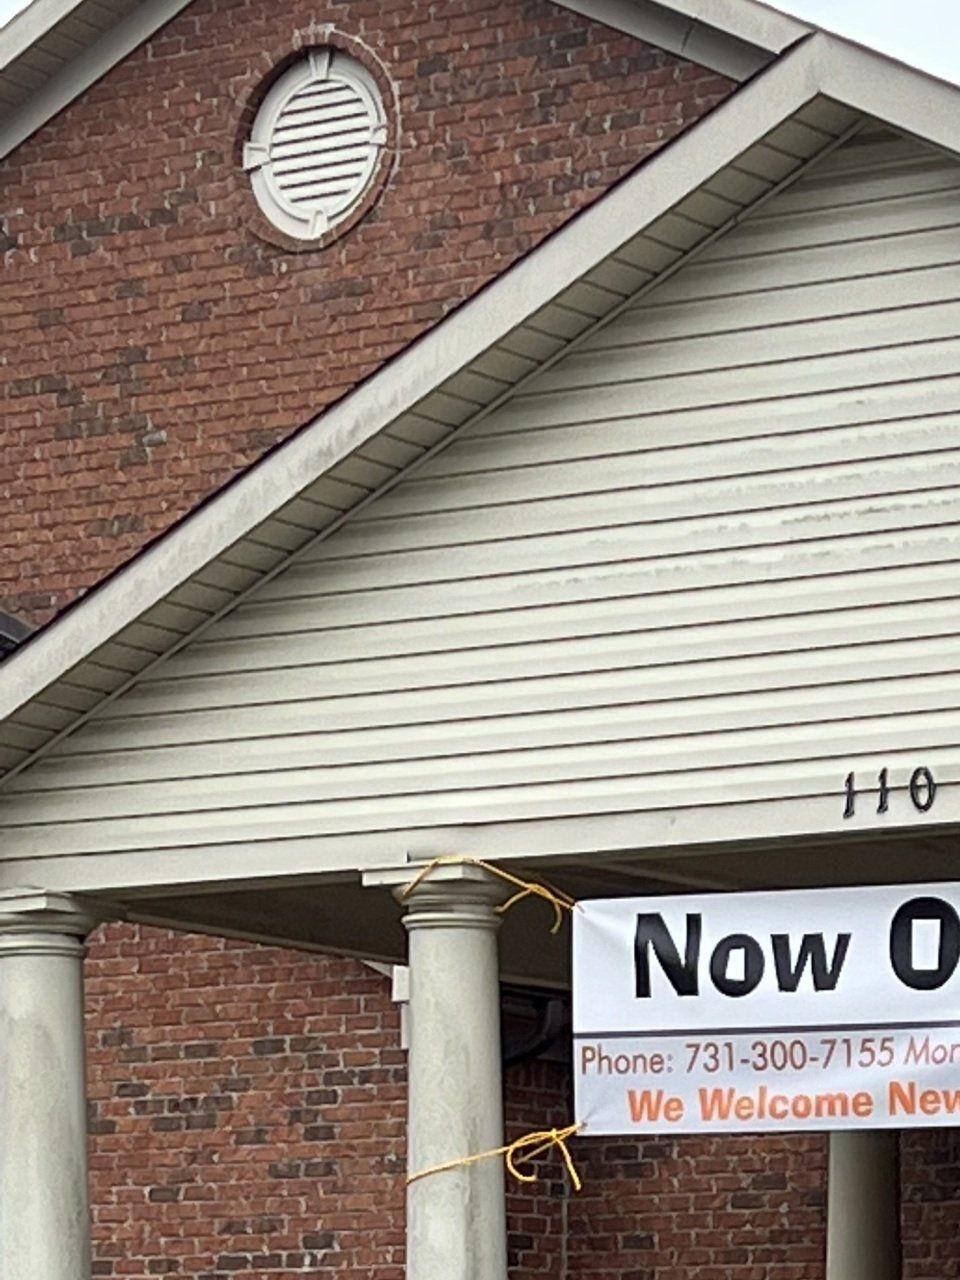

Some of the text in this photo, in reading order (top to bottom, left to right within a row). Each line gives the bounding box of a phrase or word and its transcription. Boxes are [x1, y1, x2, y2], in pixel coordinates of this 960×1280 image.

[842, 766, 937, 818] 110
[633, 911, 852, 999] Now
[581, 1043, 674, 1076] Phone:
[684, 1035, 895, 1073] 731-300-7155
[628, 1089, 684, 1123] We
[699, 1084, 874, 1123] Welcome
